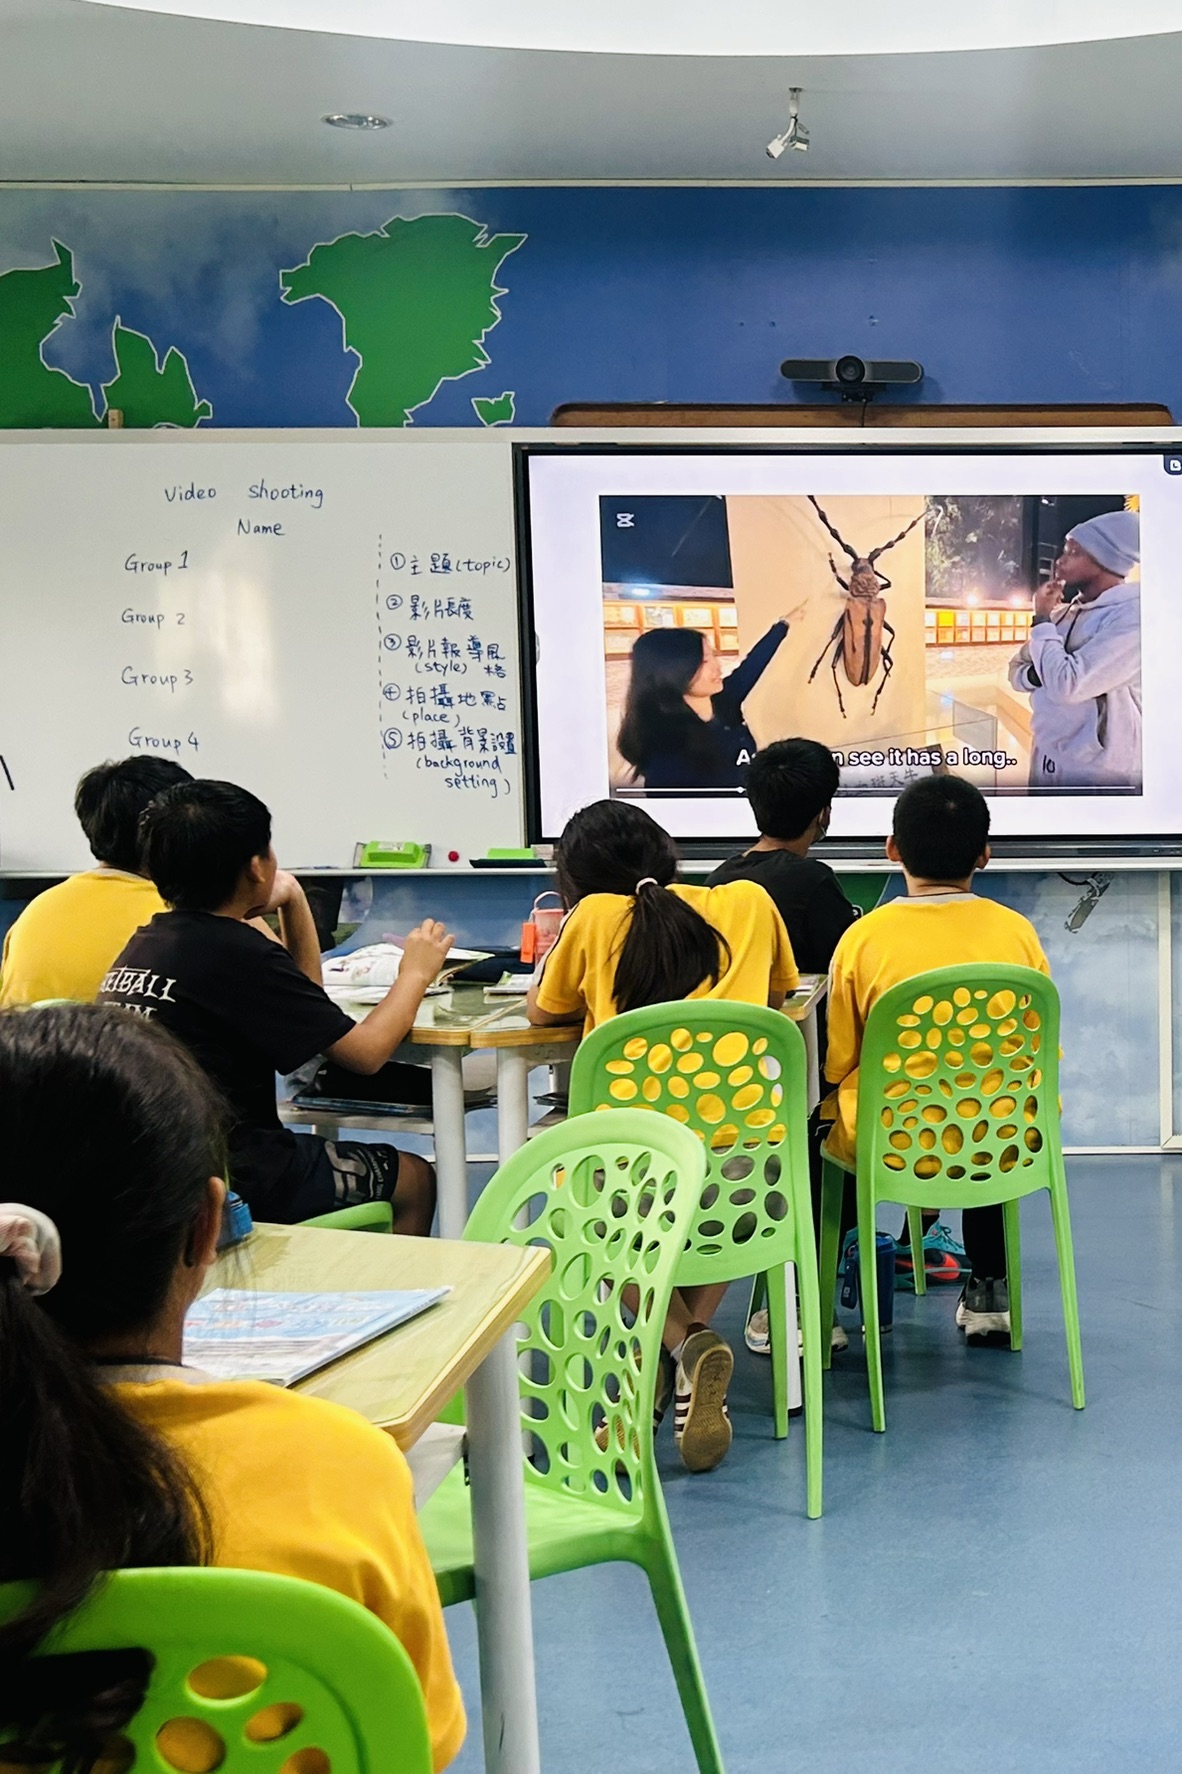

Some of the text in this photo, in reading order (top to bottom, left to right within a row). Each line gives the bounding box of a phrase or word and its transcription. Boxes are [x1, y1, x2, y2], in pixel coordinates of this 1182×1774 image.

[164, 482, 217, 502] Video
[237, 518, 286, 536] Name
[124, 550, 188, 576] Group 1
[121, 608, 186, 630] Group 2
[121, 666, 194, 693] Group 3
[128, 727, 199, 755] Group 4
[849, 752, 884, 766] see
[888, 749, 902, 766] it
[906, 749, 943, 766] has
[946, 752, 959, 766] a
[962, 748, 1018, 770] long..
